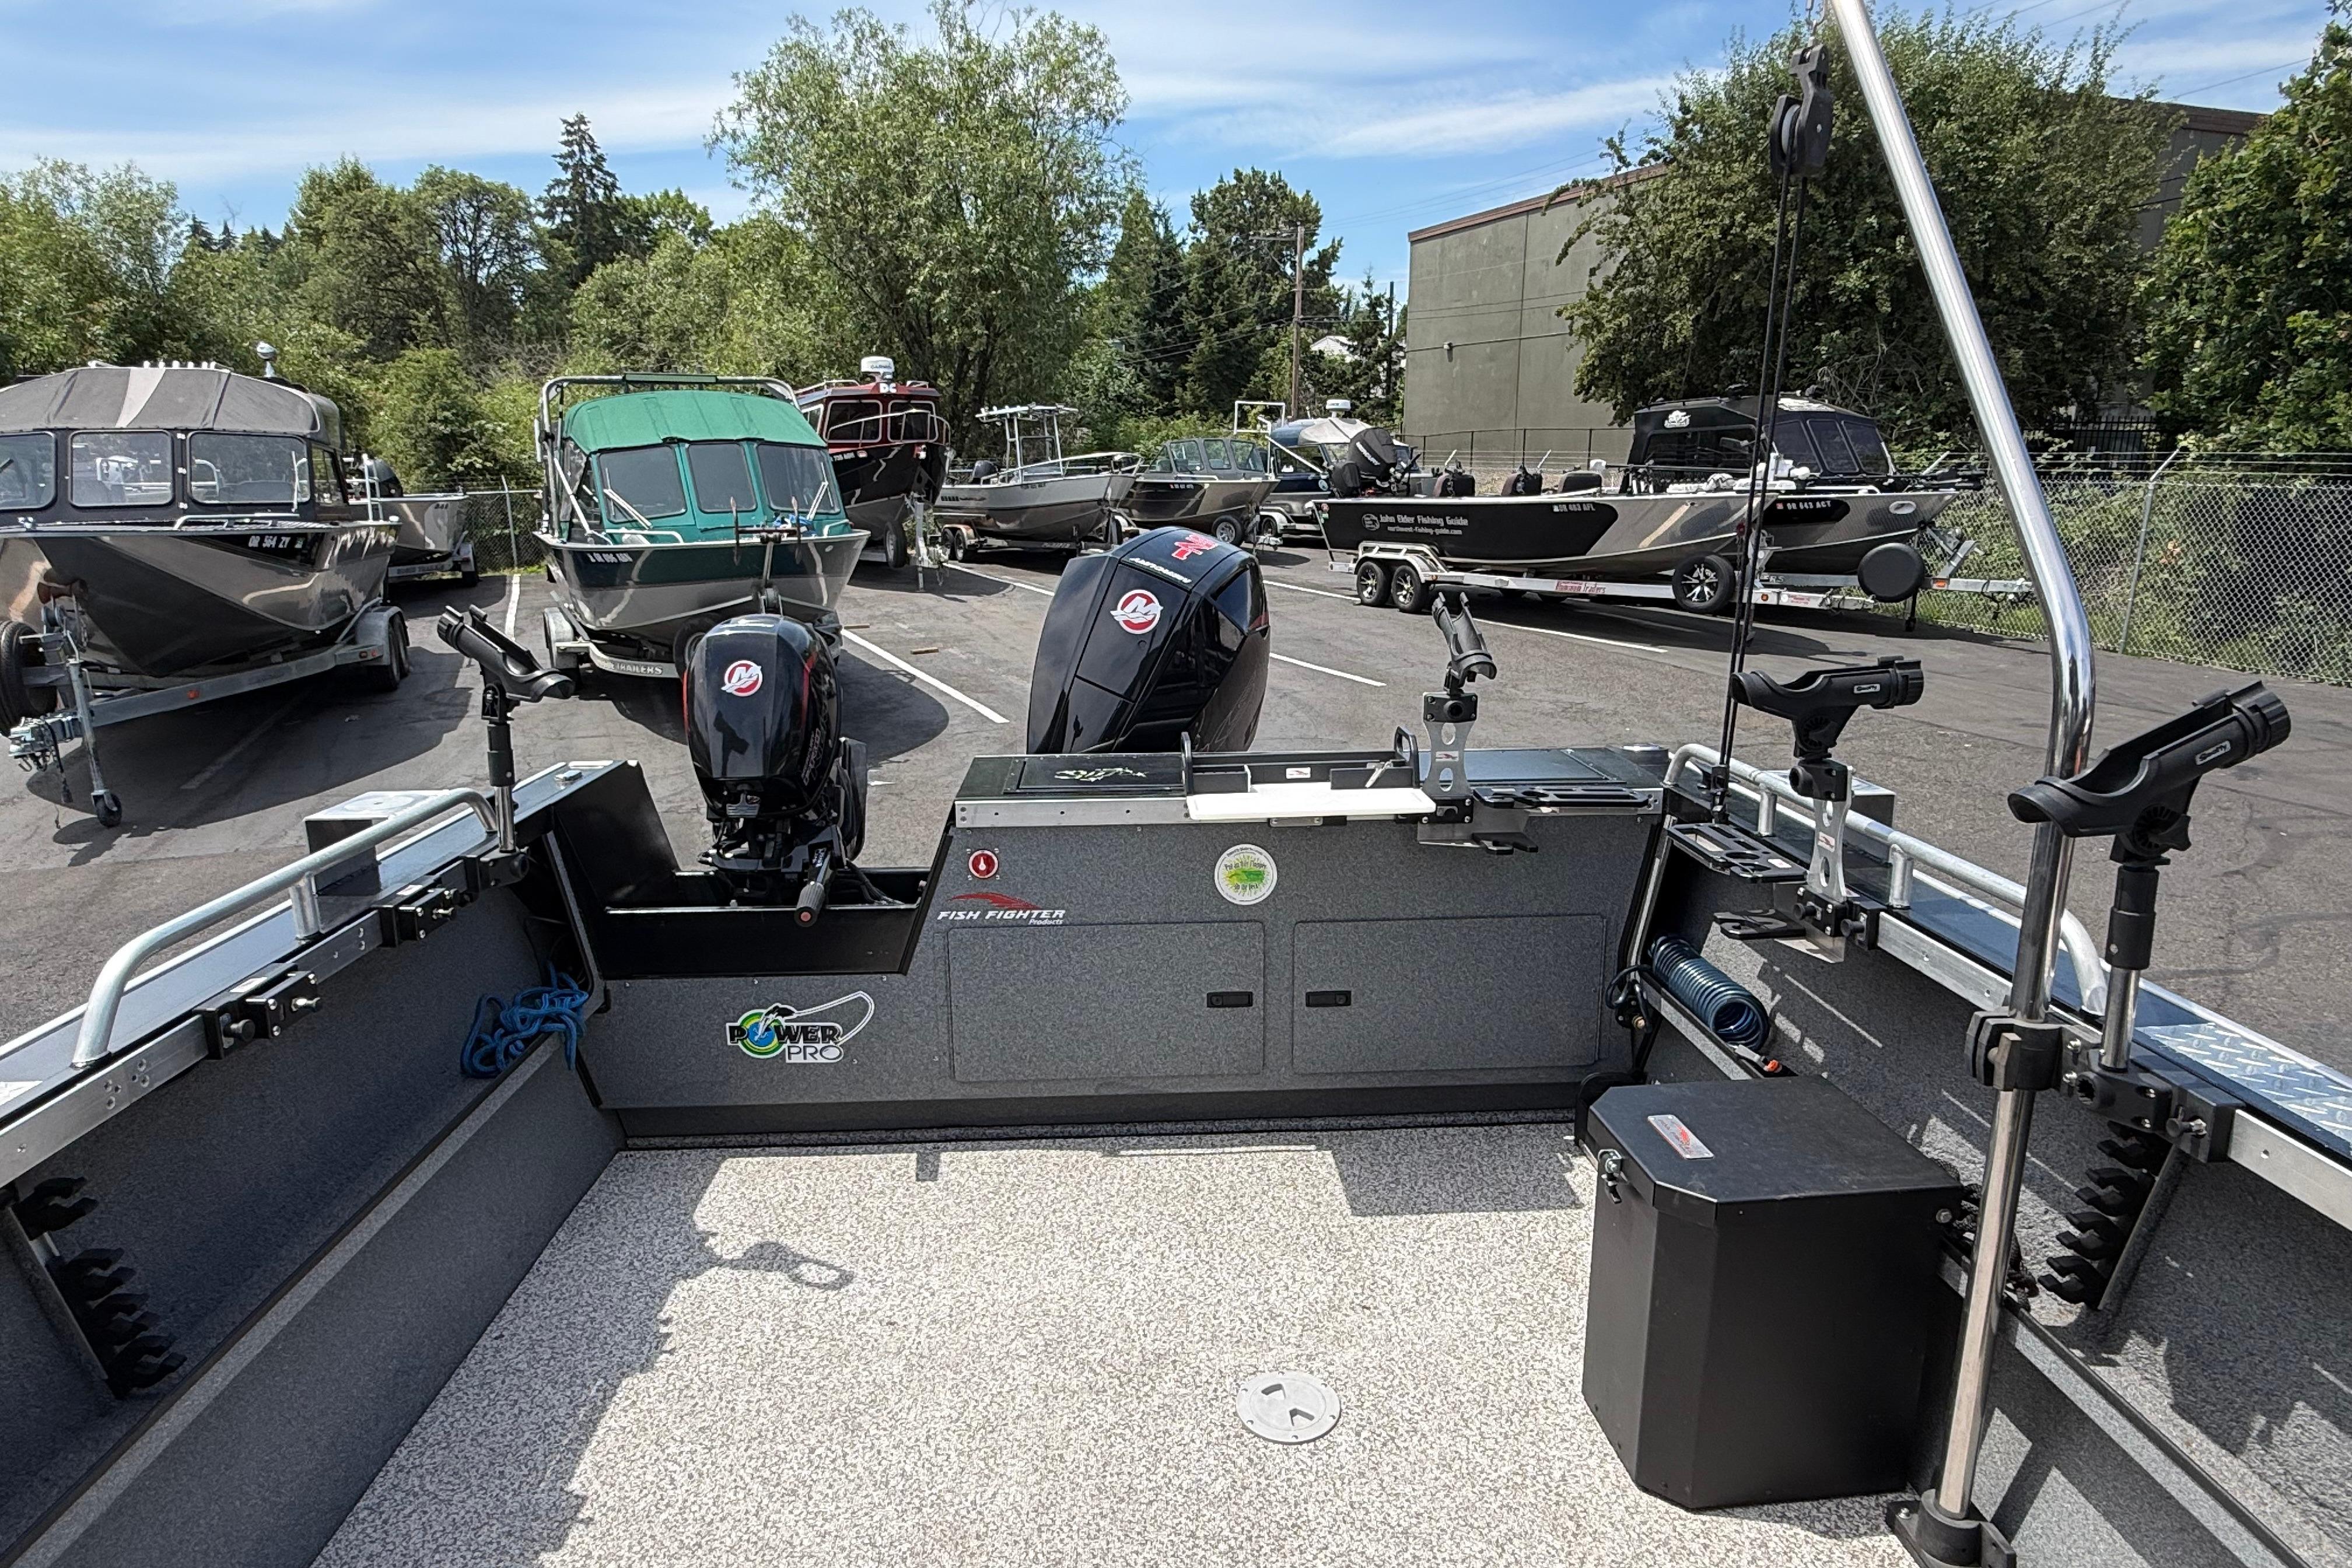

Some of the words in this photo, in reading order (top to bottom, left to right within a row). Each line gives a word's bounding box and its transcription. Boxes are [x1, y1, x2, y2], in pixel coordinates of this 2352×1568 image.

[880, 383, 897, 393] DC
[1380, 514, 1395, 523] John
[1396, 514, 1415, 523] Elder
[1417, 515, 1444, 526] Fishing
[1446, 516, 1469, 526] Guide
[1129, 558, 1192, 583] MERCURY
[617, 663, 663, 675] TRAILERS
[937, 911, 981, 921] FISH
[985, 909, 1066, 920] FIGHTER
[788, 1045, 842, 1060] PRO
